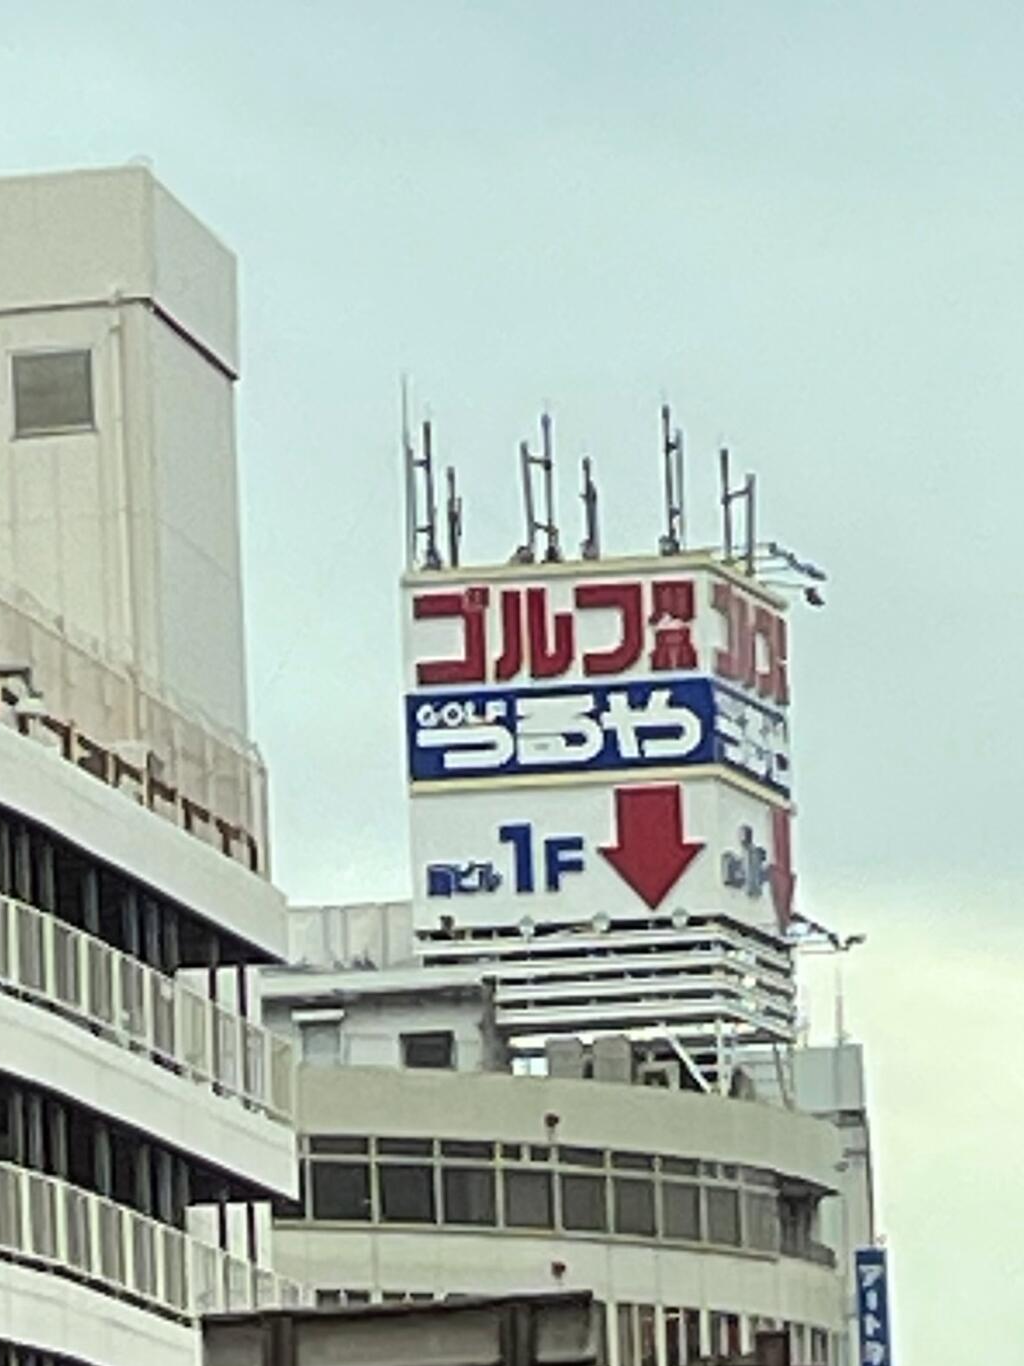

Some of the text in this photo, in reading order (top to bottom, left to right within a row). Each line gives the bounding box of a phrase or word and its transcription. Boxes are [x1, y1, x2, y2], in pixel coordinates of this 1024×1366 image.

[415, 690, 703, 770] つるや
[416, 699, 507, 728] GOLF
